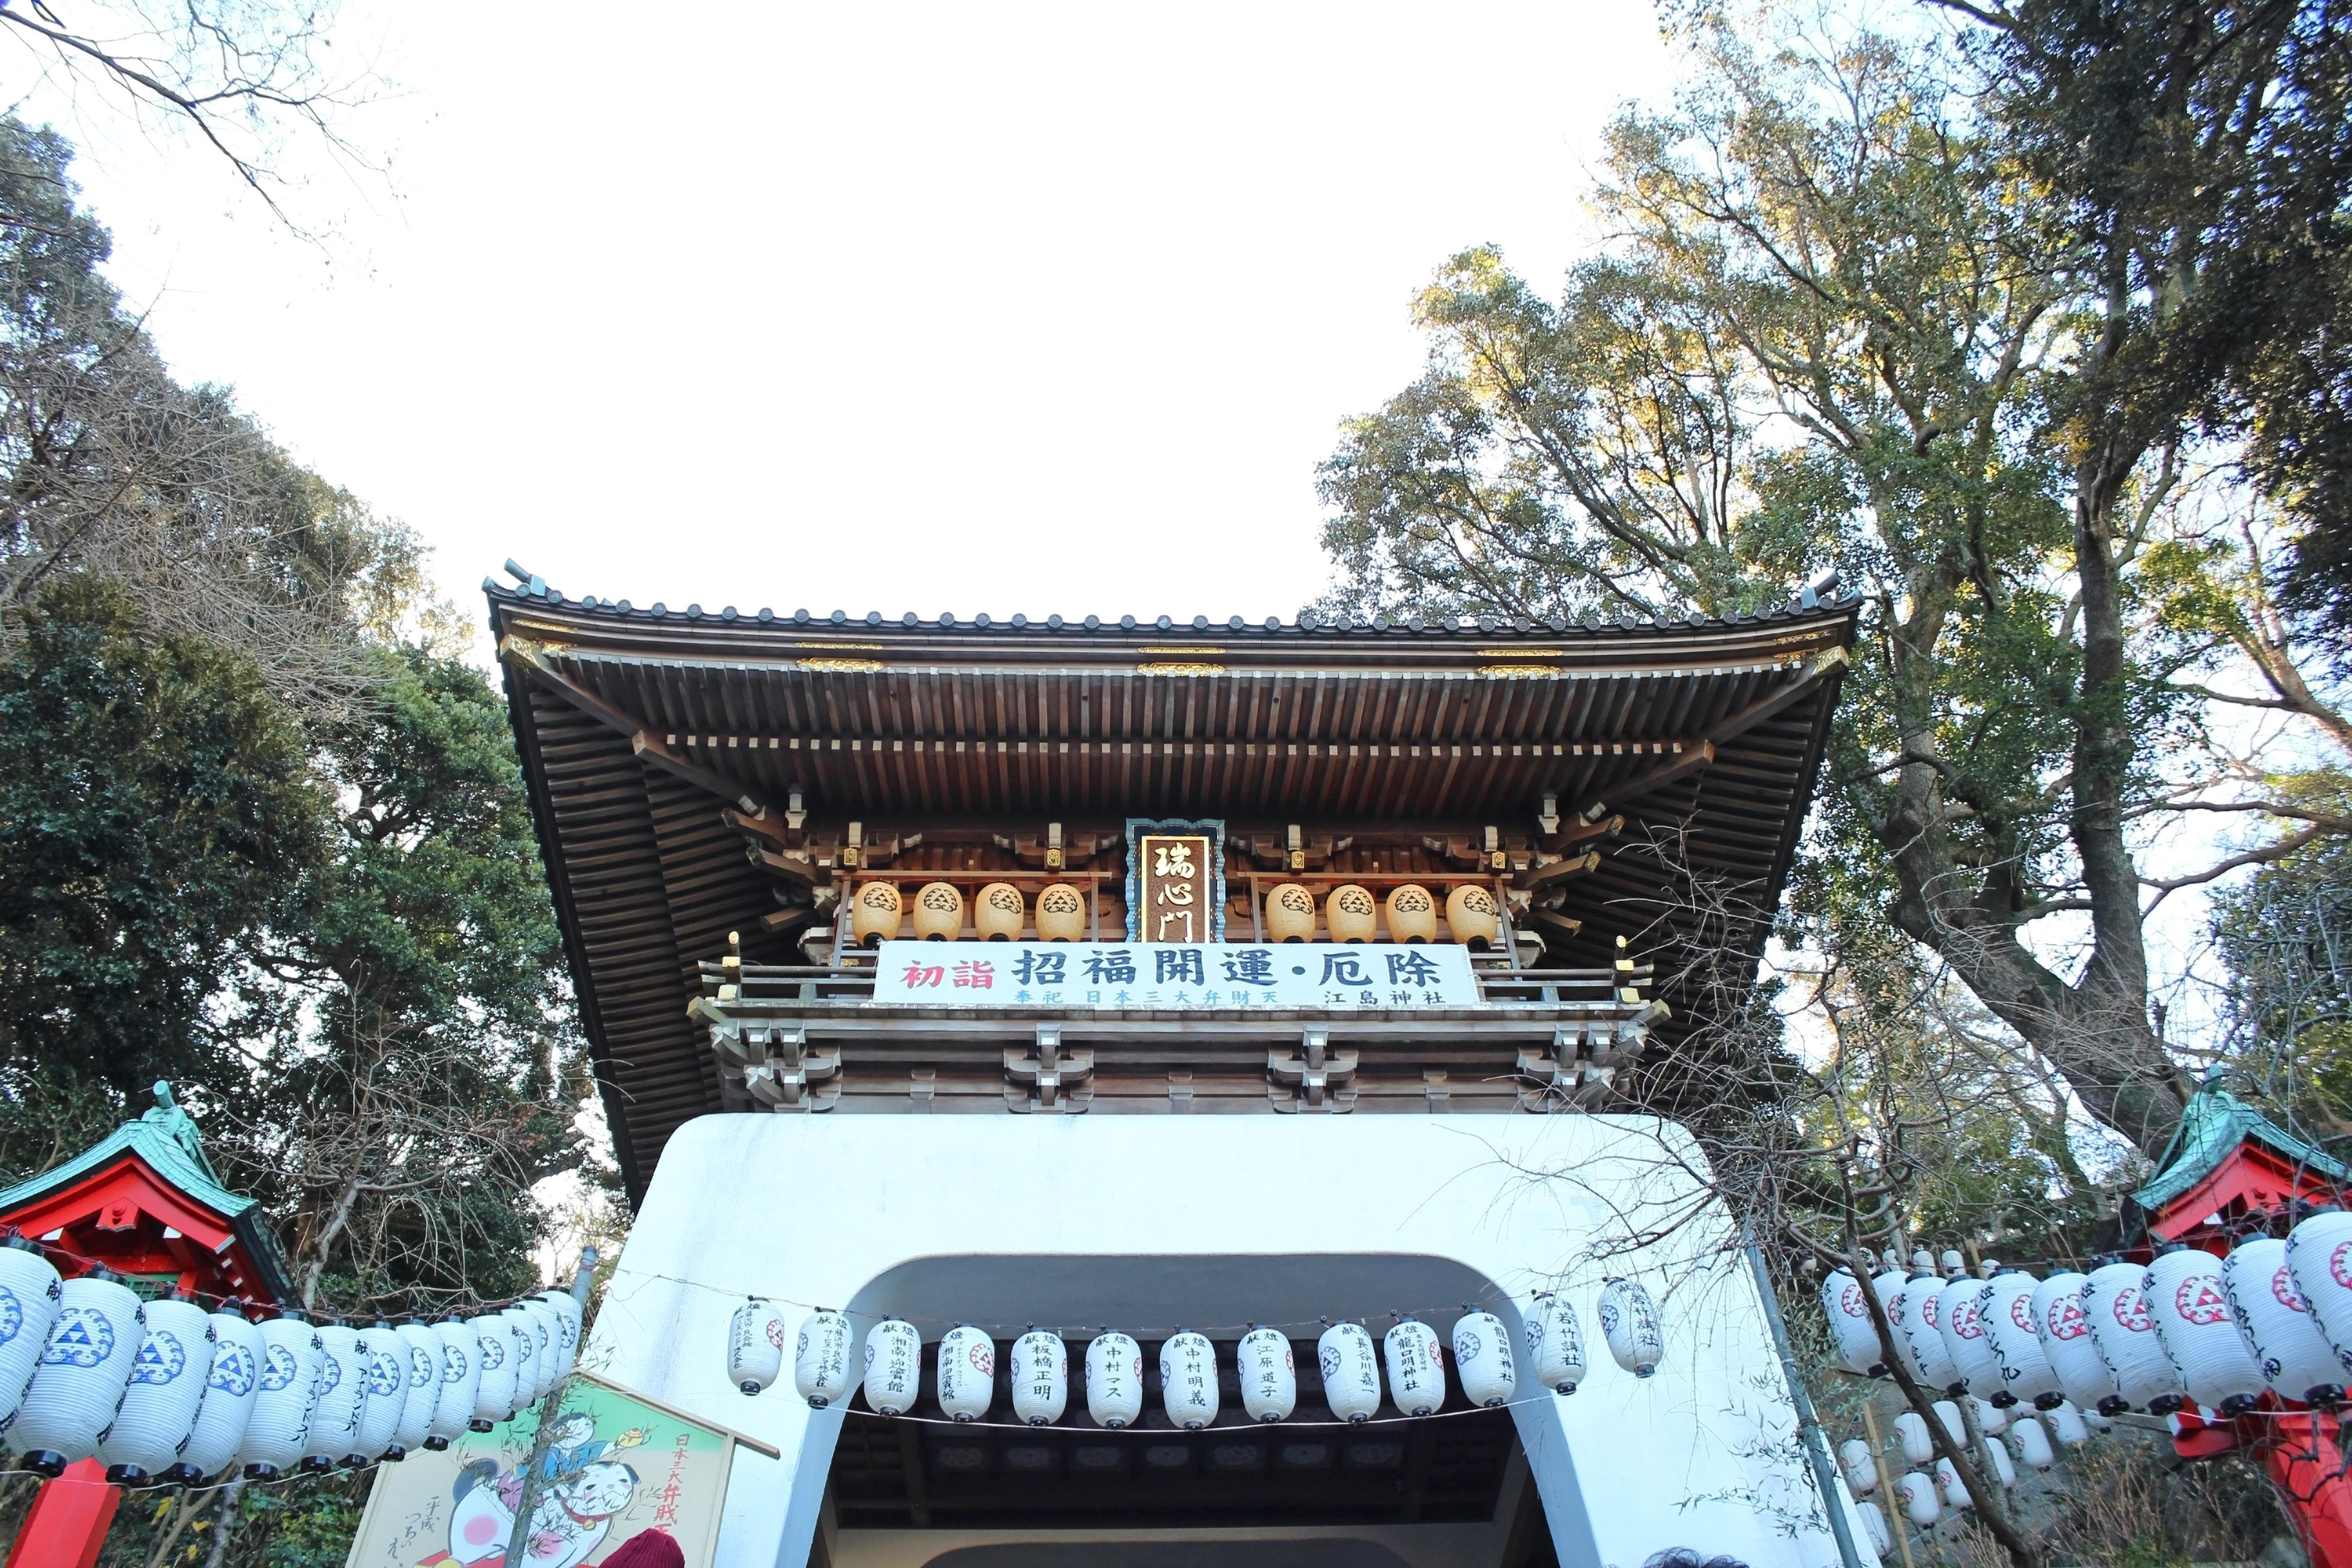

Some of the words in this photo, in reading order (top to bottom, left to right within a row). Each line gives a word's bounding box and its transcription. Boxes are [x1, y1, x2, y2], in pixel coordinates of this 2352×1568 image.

[1155, 842, 1196, 943] 瑞心門
[899, 960, 996, 990] 初詣
[1011, 949, 1441, 987] 招福開運・厄除
[1014, 990, 1063, 1004] 奉祀
[1087, 990, 1280, 1005] 日本三大弁財天
[1324, 990, 1446, 1005] 江島神社
[817, 1316, 848, 1331] 献燈
[883, 1324, 914, 1337] 献燈
[1024, 1334, 1057, 1345] 献燈
[1096, 1335, 1129, 1348] 献燈
[1174, 1337, 1206, 1349] 献燈
[1247, 1332, 1279, 1345] 献燈
[1389, 1325, 1418, 1340] 献燈
[886, 1336, 907, 1393] 湘南迎賓館
[941, 1346, 955, 1401] 湘南迎賓館
[1031, 1344, 1053, 1401] 板橋正明
[1103, 1347, 1122, 1397] 中村マス
[1184, 1348, 1206, 1406] 中村明義
[1256, 1345, 1278, 1397] 江原道子
[1355, 1338, 1375, 1394] 長谷川嘉一
[1396, 1337, 1421, 1392] 龍口明神社
[421, 1496, 440, 1533] 平成
